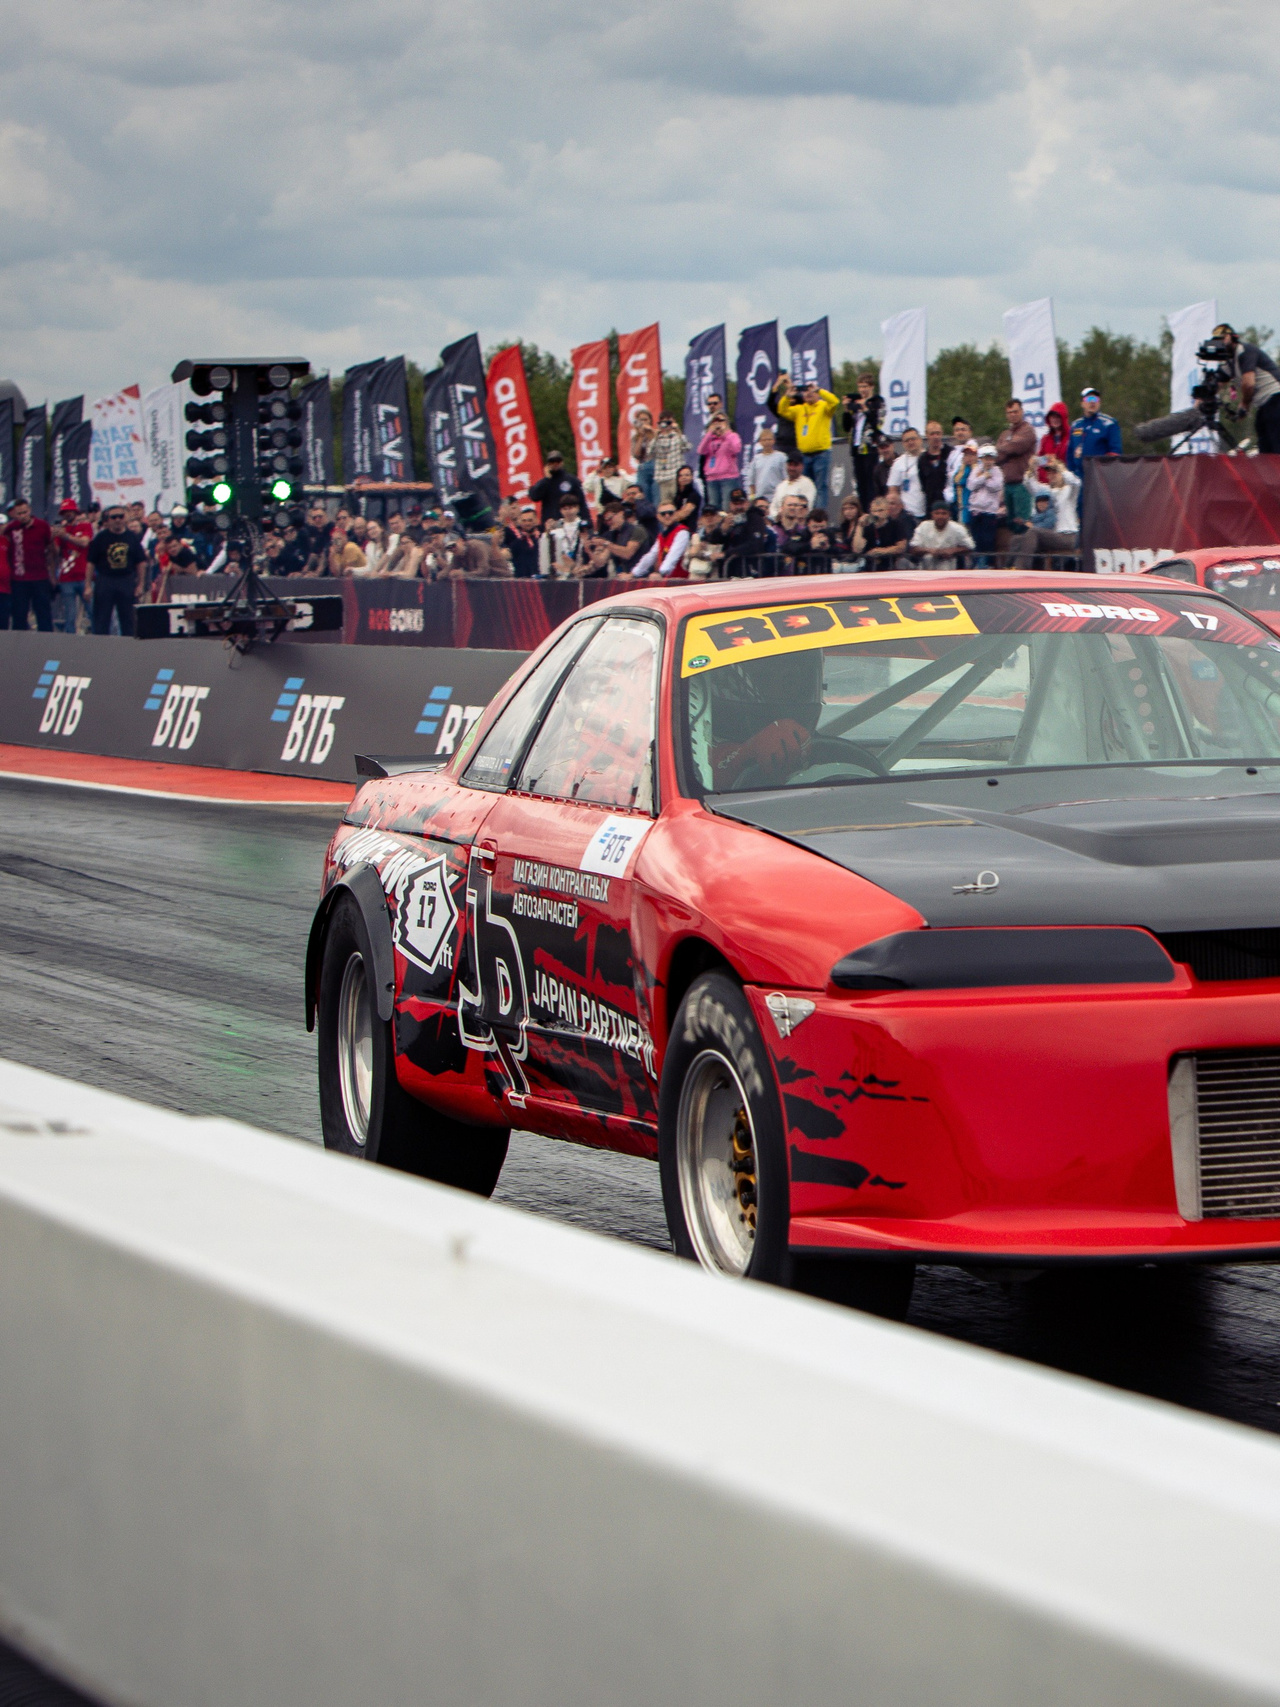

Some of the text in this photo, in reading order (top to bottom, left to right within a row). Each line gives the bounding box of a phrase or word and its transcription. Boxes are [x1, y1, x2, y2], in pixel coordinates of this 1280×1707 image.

[699, 595, 961, 652] RDRC
[1041, 602, 1218, 631] RDRC 17
[39, 674, 92, 736] ВТБ
[152, 684, 211, 750] ВТБ
[280, 694, 346, 764] ВТБ
[435, 704, 487, 755] ВТ
[601, 834, 632, 863] ВТБ
[513, 859, 610, 902] МАГАЗИН КОНТРАКТНЫХ
[417, 894, 437, 929] 17
[512, 892, 578, 929] АВТОЗАПЧАСТЕЙ
[533, 970, 578, 1027] JAPAN
